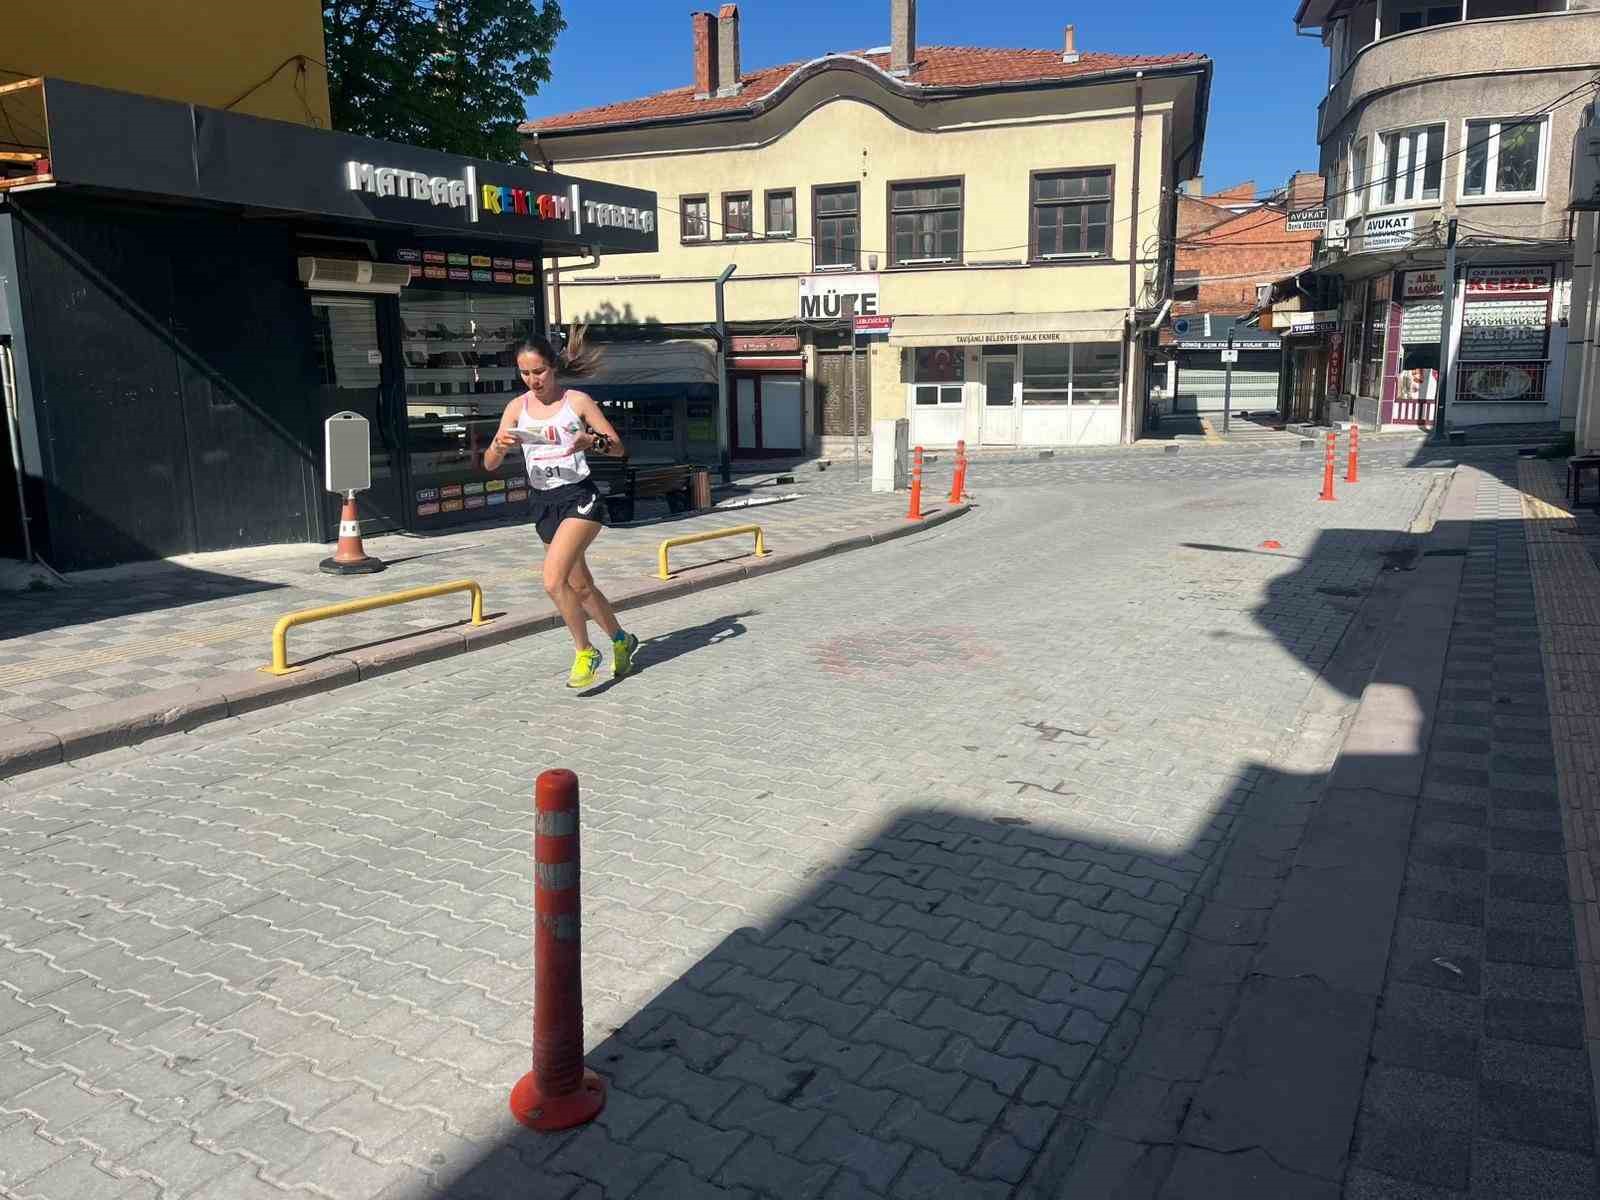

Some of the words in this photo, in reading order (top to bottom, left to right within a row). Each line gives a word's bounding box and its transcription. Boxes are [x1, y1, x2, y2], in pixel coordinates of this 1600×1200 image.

[344, 161, 466, 208] MATBAA
[481, 184, 570, 220] REKLAM
[585, 200, 654, 233] TABELA
[1291, 210, 1325, 221] AVUKAT
[1367, 217, 1410, 231] AVUKAT
[544, 465, 561, 478] 31
